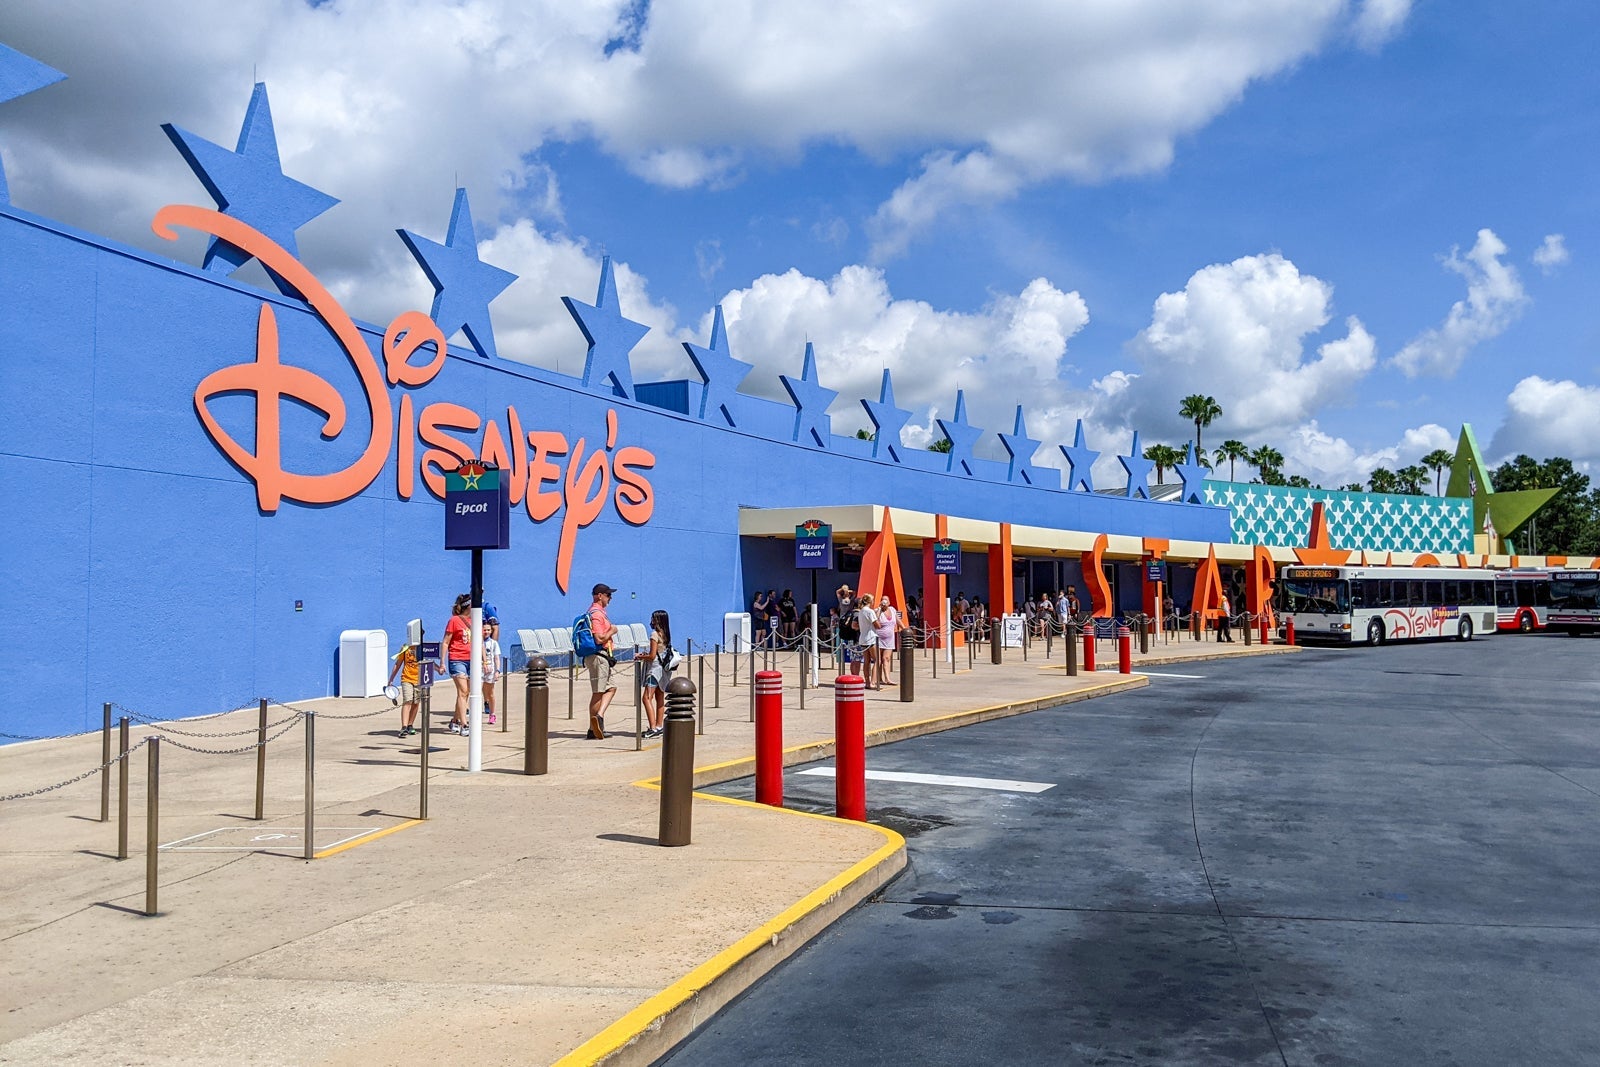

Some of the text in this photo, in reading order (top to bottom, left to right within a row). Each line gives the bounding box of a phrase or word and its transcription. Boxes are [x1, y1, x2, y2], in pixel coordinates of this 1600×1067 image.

[455, 502, 488, 515] Epcot
[1295, 570, 1332, 578] DISNEY SPRINGS
[1082, 533, 1276, 632] STAR
